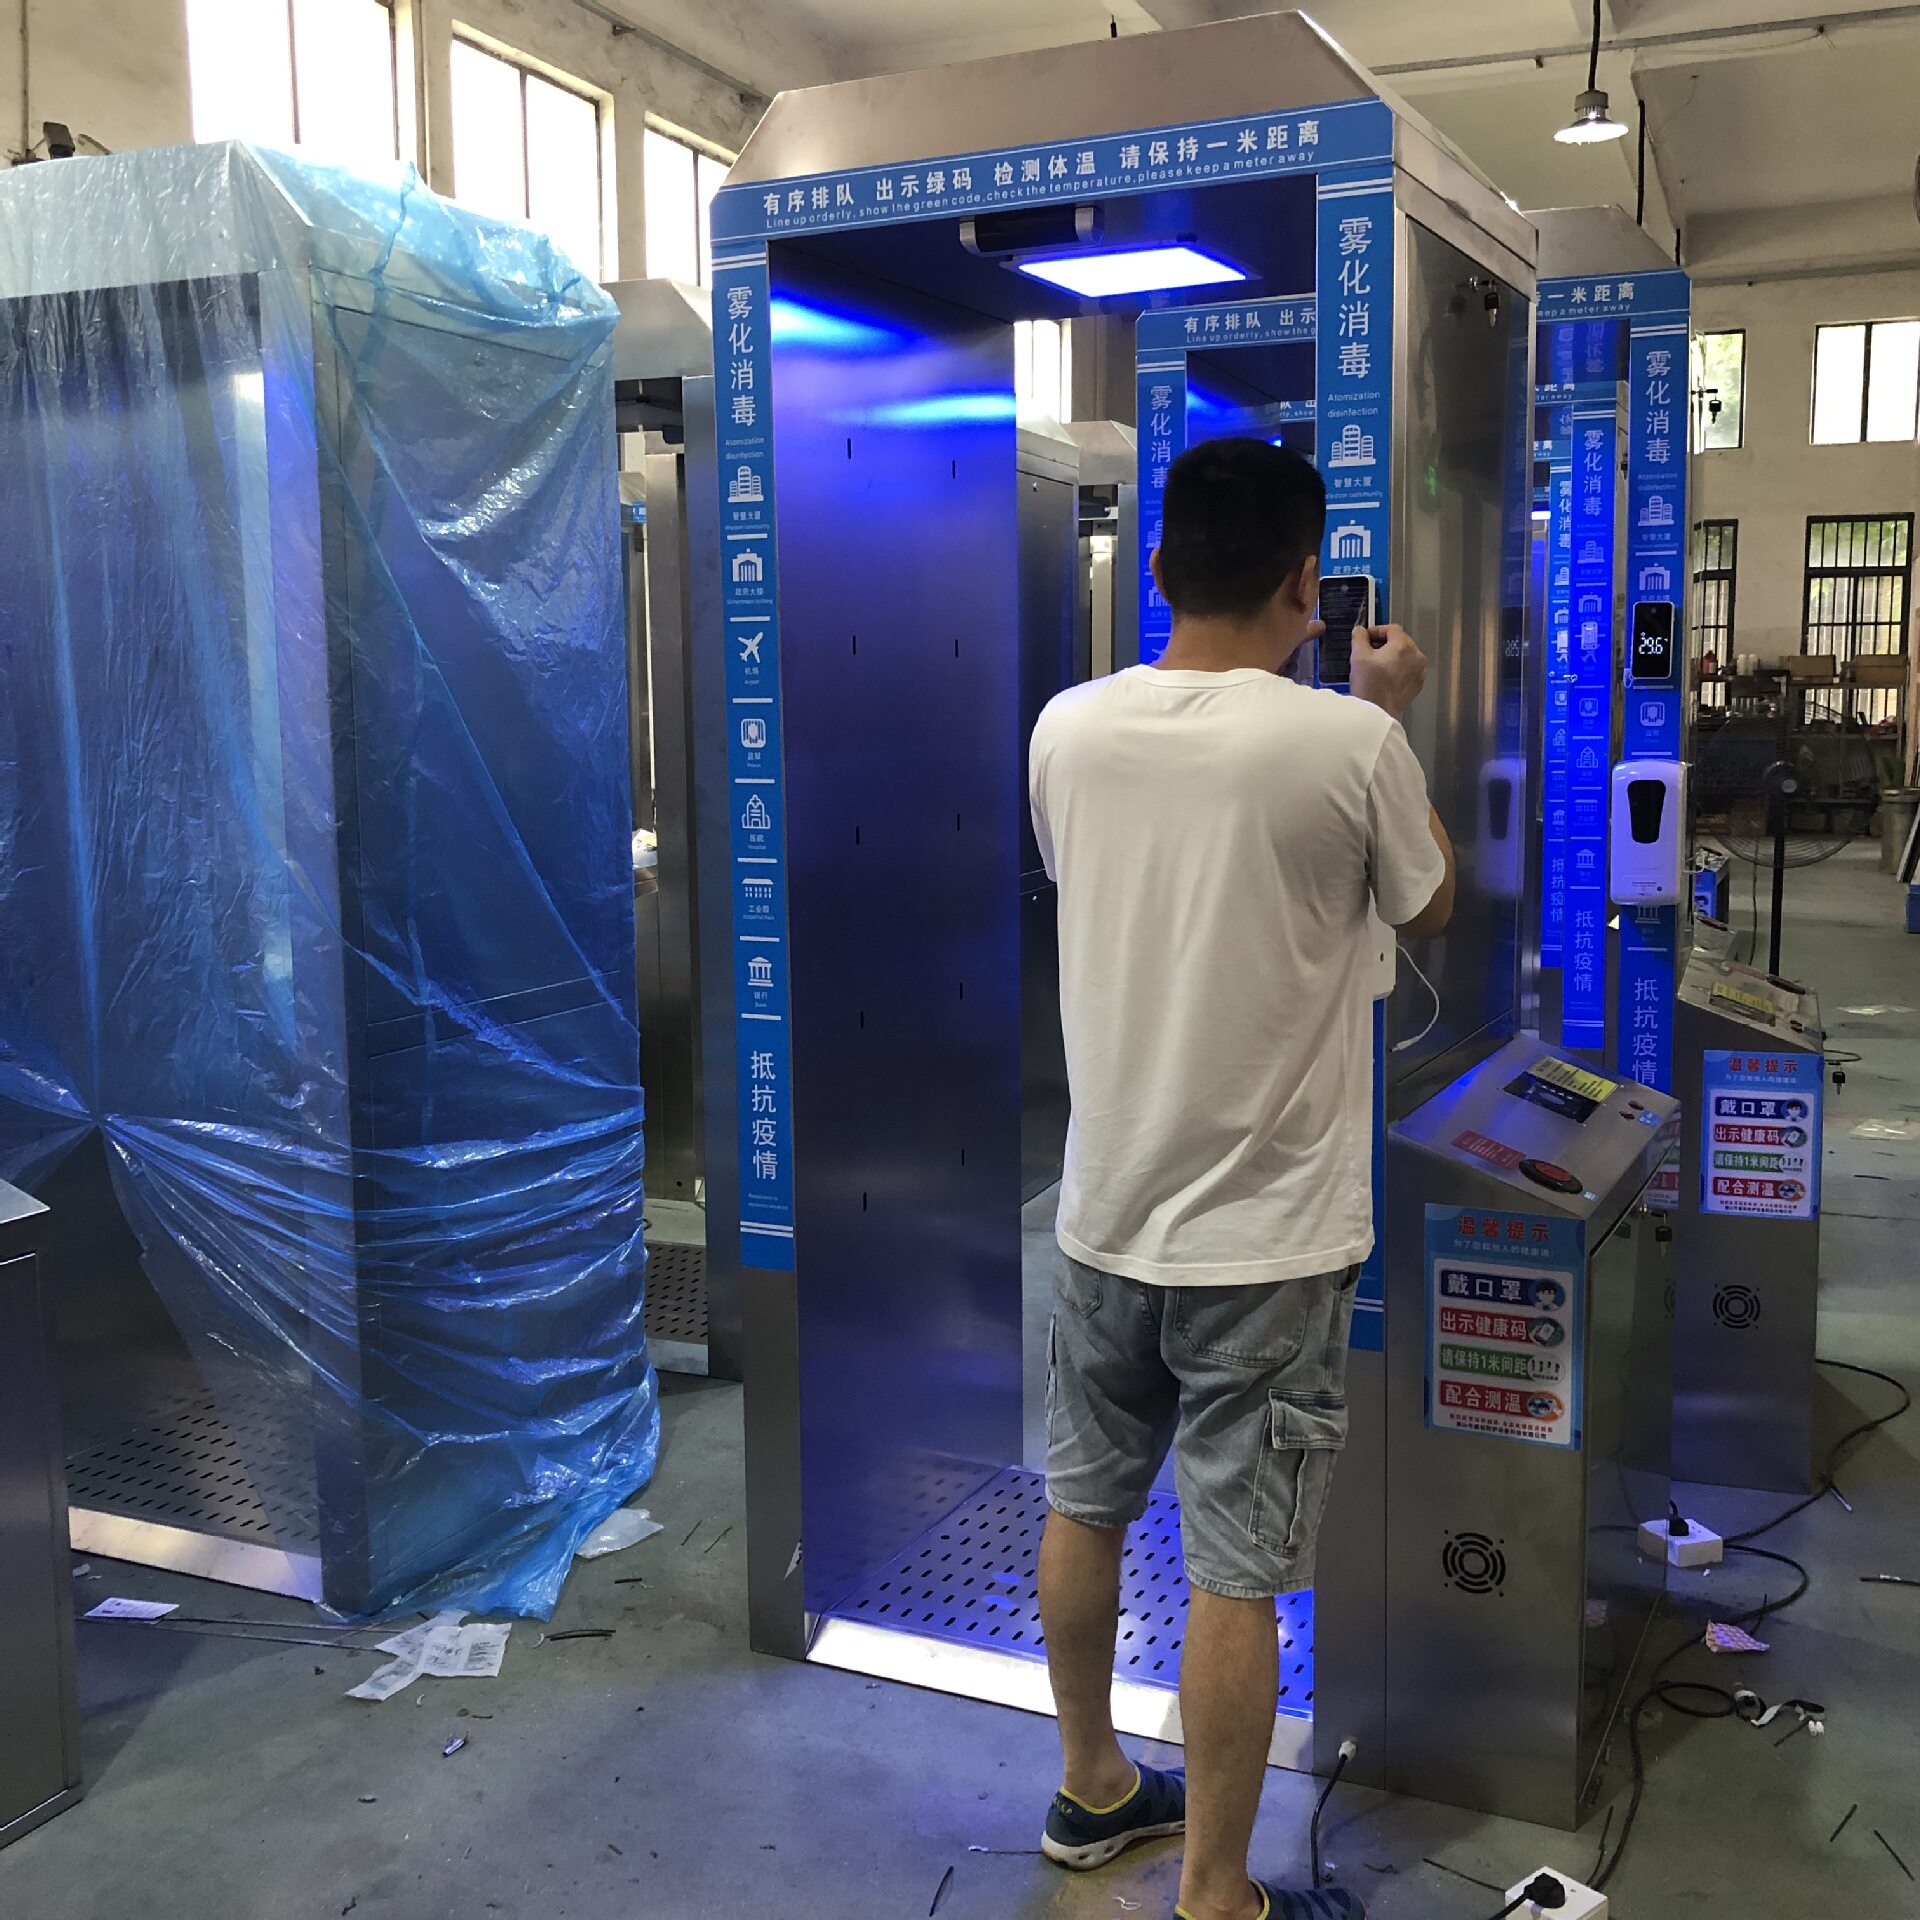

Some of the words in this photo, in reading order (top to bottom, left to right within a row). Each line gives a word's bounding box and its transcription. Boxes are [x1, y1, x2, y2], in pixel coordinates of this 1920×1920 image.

[763, 182, 854, 216] 有序排队
[876, 168, 972, 201] 出示绿码
[993, 151, 1096, 186] 检测体温
[1119, 120, 1320, 169] 请保持一米距离
[766, 218, 790, 228] Line
[793, 215, 807, 226] up
[859, 203, 889, 217] show
[892, 202, 911, 213] the
[913, 199, 948, 213] green
[1026, 183, 1046, 196] the
[1186, 163, 1220, 176] keep
[1223, 162, 1230, 171] a
[1233, 154, 1275, 169] meter
[1278, 150, 1315, 164] away
[1337, 216, 1373, 379] 雾化消毒
[1184, 311, 1261, 333] 有序排队
[726, 286, 757, 427] 雾化消毒
[1327, 391, 1381, 402] Atomization
[1645, 350, 1672, 465] 雾化消毒
[1327, 406, 1379, 418] disinfection
[1584, 429, 1604, 517] 雾化消毒
[1573, 909, 1595, 993] 抵抗疫情
[1632, 977, 1659, 1085] 抵抗疫情
[1728, 1057, 1798, 1073] 温馨提示
[750, 1050, 779, 1182] 抵抗疫情
[1719, 1099, 1776, 1117] 戴口罩
[1715, 1127, 1780, 1144] 出示健康码
[1717, 1179, 1775, 1197] 配合测温
[1458, 1215, 1550, 1242] 温馨提示
[1447, 1273, 1522, 1301] 戴口罩
[1441, 1311, 1527, 1340] 出示健康码
[1441, 1348, 1527, 1376] 请保持1米间距
[1445, 1383, 1521, 1413] 配合测温
